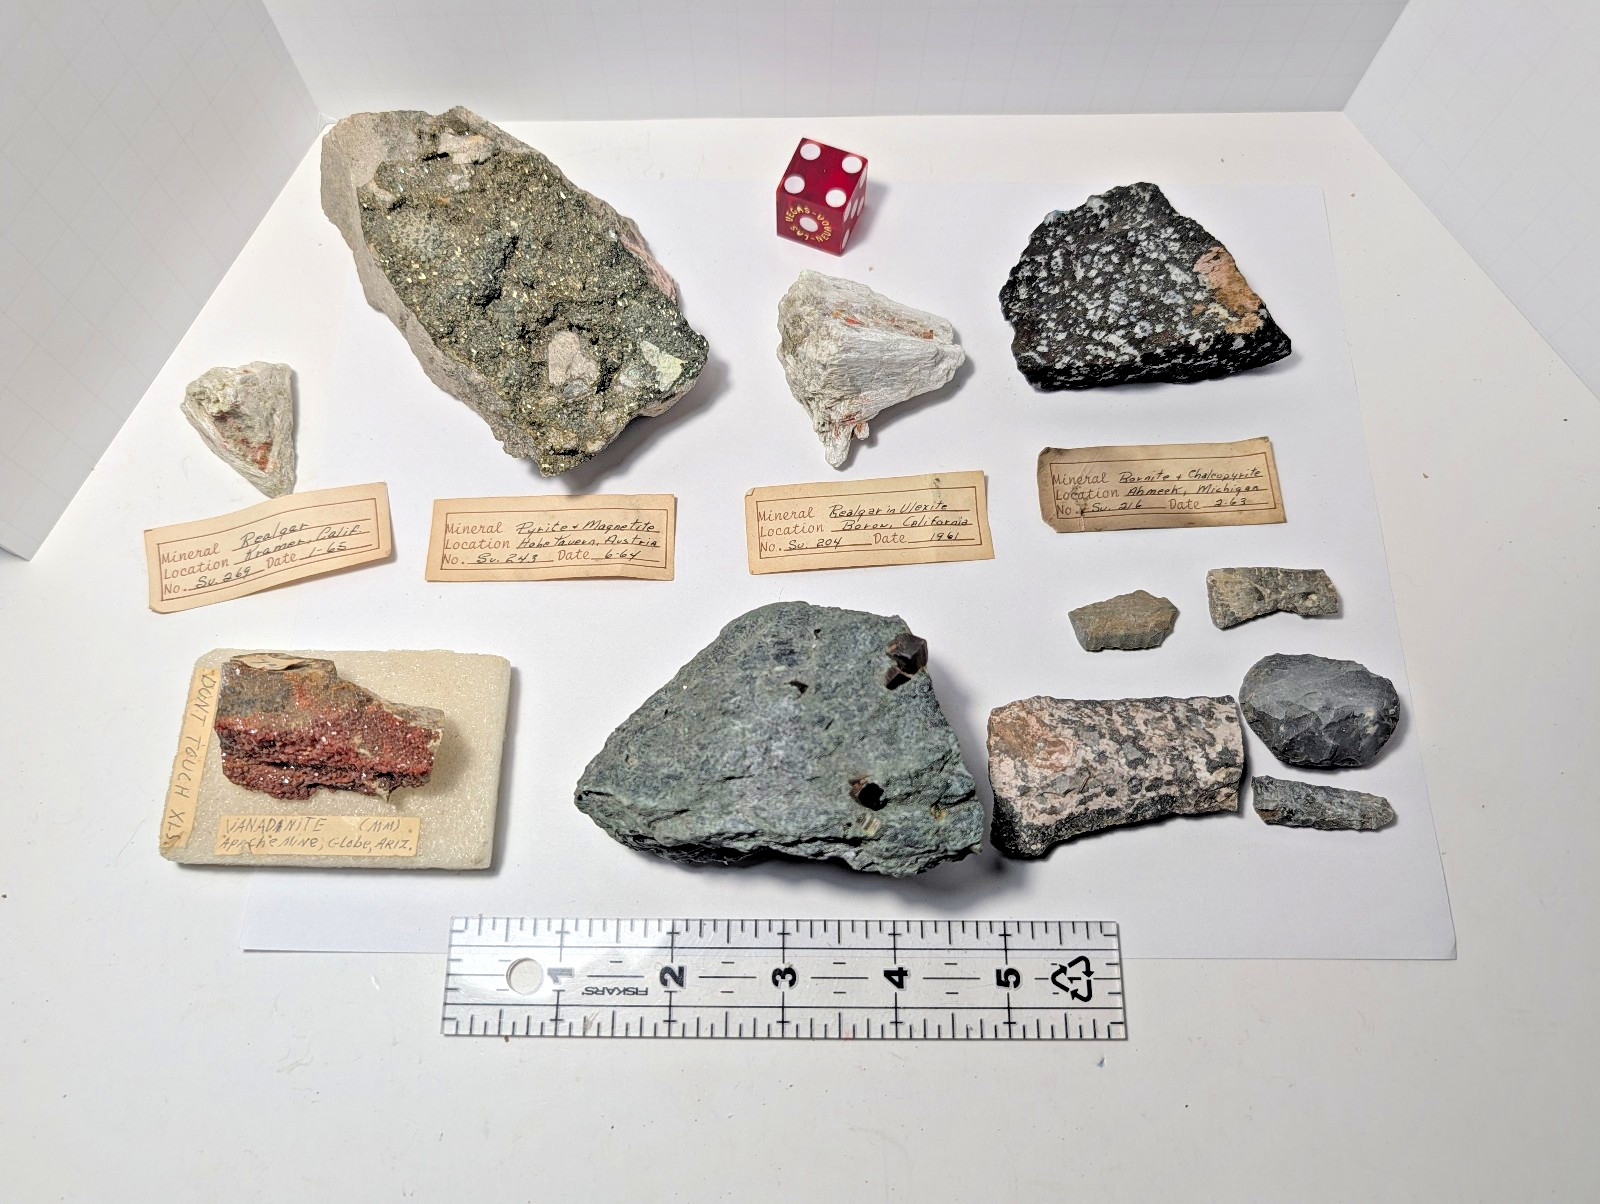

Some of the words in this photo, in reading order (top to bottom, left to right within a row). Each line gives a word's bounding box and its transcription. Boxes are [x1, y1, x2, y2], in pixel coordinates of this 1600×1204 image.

[785, 206, 811, 222] VEGAS
[1052, 472, 1108, 486] Mineral
[1119, 470, 1170, 482] Bornite
[1055, 488, 1119, 501] Location
[1196, 484, 1259, 497] Michigan
[758, 508, 815, 522] Mineral
[829, 504, 882, 521] Realgar
[900, 500, 947, 514] Ulexite
[1057, 505, 1079, 516] No.
[1168, 498, 1201, 510] Date
[445, 522, 503, 535] Mineral
[515, 521, 567, 538] Pyrite
[583, 519, 656, 534] Magnetite
[760, 524, 824, 537] Location
[903, 516, 969, 528] California
[162, 543, 220, 564] Mineral
[240, 522, 310, 549] Realgar
[444, 538, 510, 550] Location
[604, 534, 657, 548] Austria
[759, 541, 783, 553] No.
[817, 537, 842, 549] 204
[873, 533, 907, 544] Date
[930, 531, 959, 541] 1961
[443, 554, 465, 565] No.
[505, 553, 538, 565] 243
[557, 549, 590, 561] Date
[164, 557, 230, 580] Location
[164, 583, 188, 595] No.
[266, 552, 297, 569] Date
[174, 736, 203, 799] TOUCH
[547, 967, 574, 984] 1
[660, 965, 687, 988] 2
[772, 966, 797, 989] 3
[884, 967, 909, 989] 4
[996, 968, 1021, 989] 5
[583, 986, 649, 996] FISKARS
